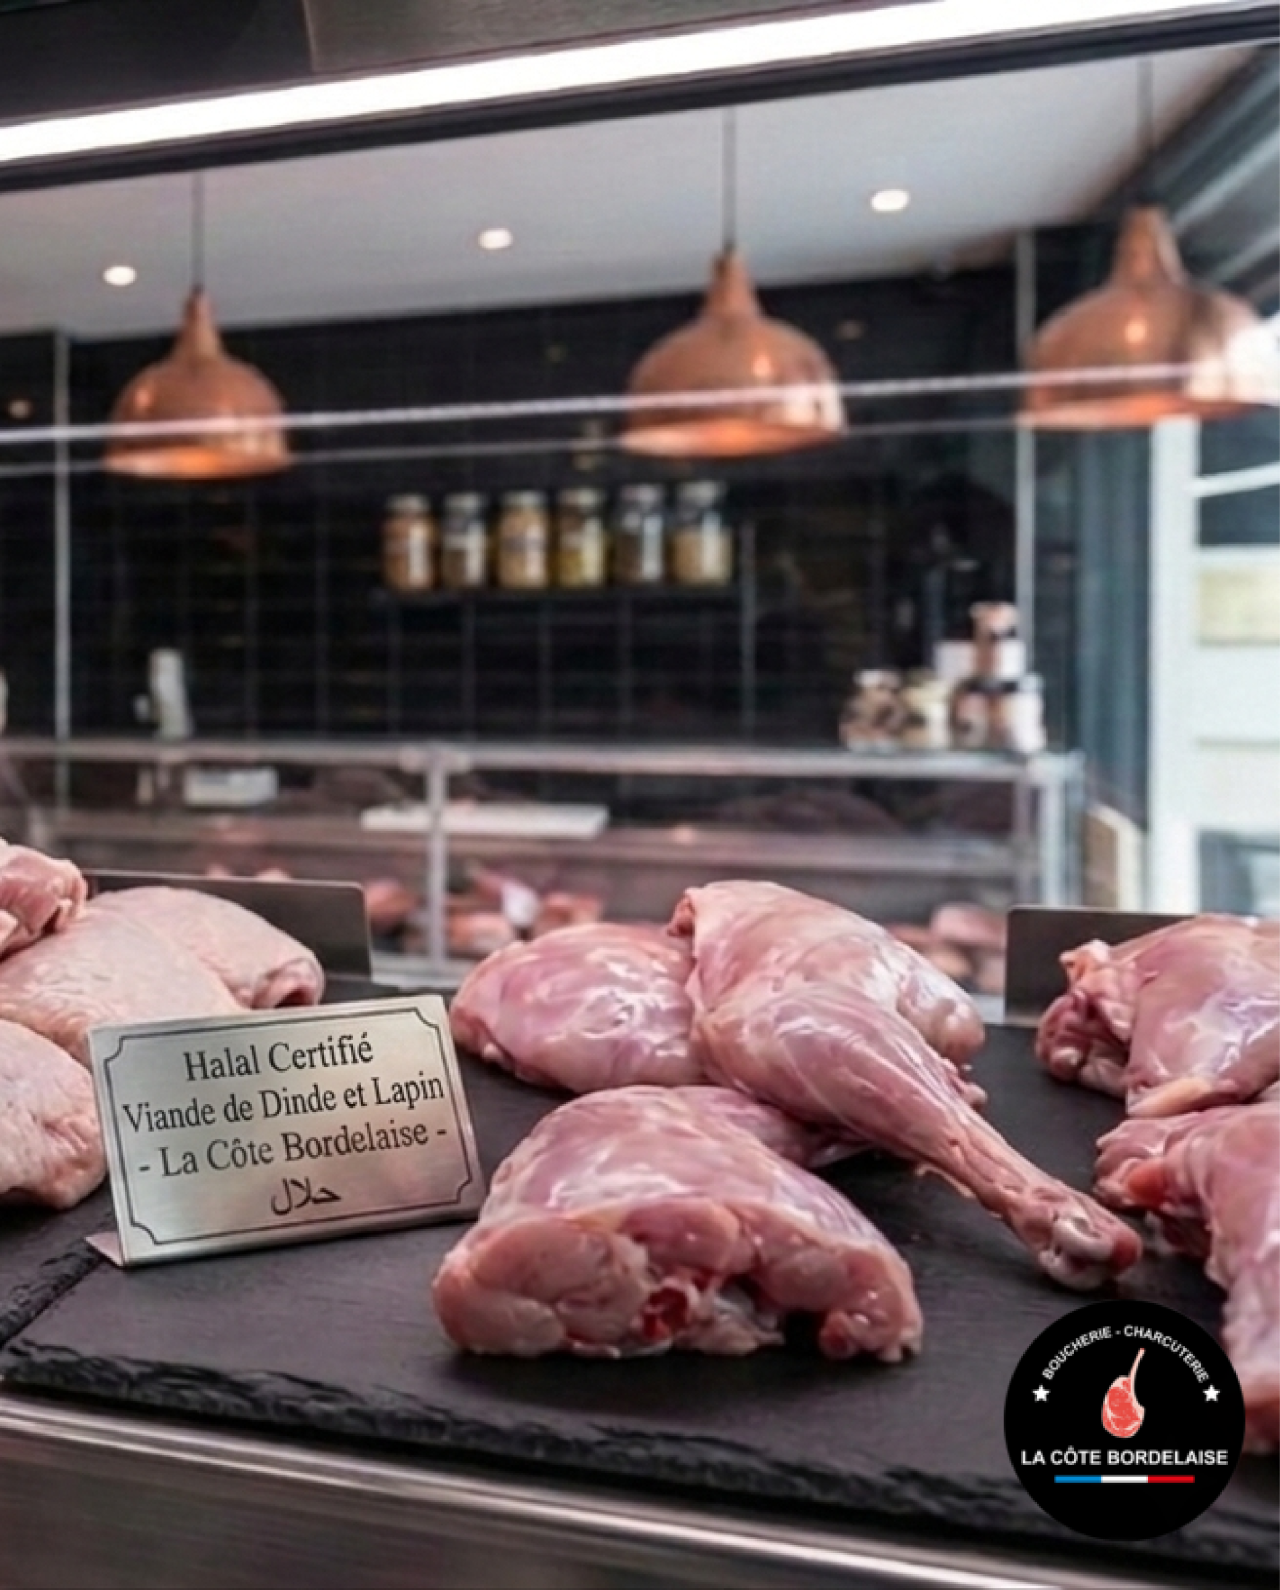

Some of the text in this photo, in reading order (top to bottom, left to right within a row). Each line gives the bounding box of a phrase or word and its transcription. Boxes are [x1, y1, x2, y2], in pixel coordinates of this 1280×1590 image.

[183, 1032, 373, 1082] Halal Certifié
[123, 1071, 445, 1133] Viande de Dinde et Lapin
[158, 1145, 199, 1178] La
[206, 1137, 275, 1171] Côte
[280, 1119, 429, 1163] Bordelaise
[270, 1176, 342, 1215] حلال
